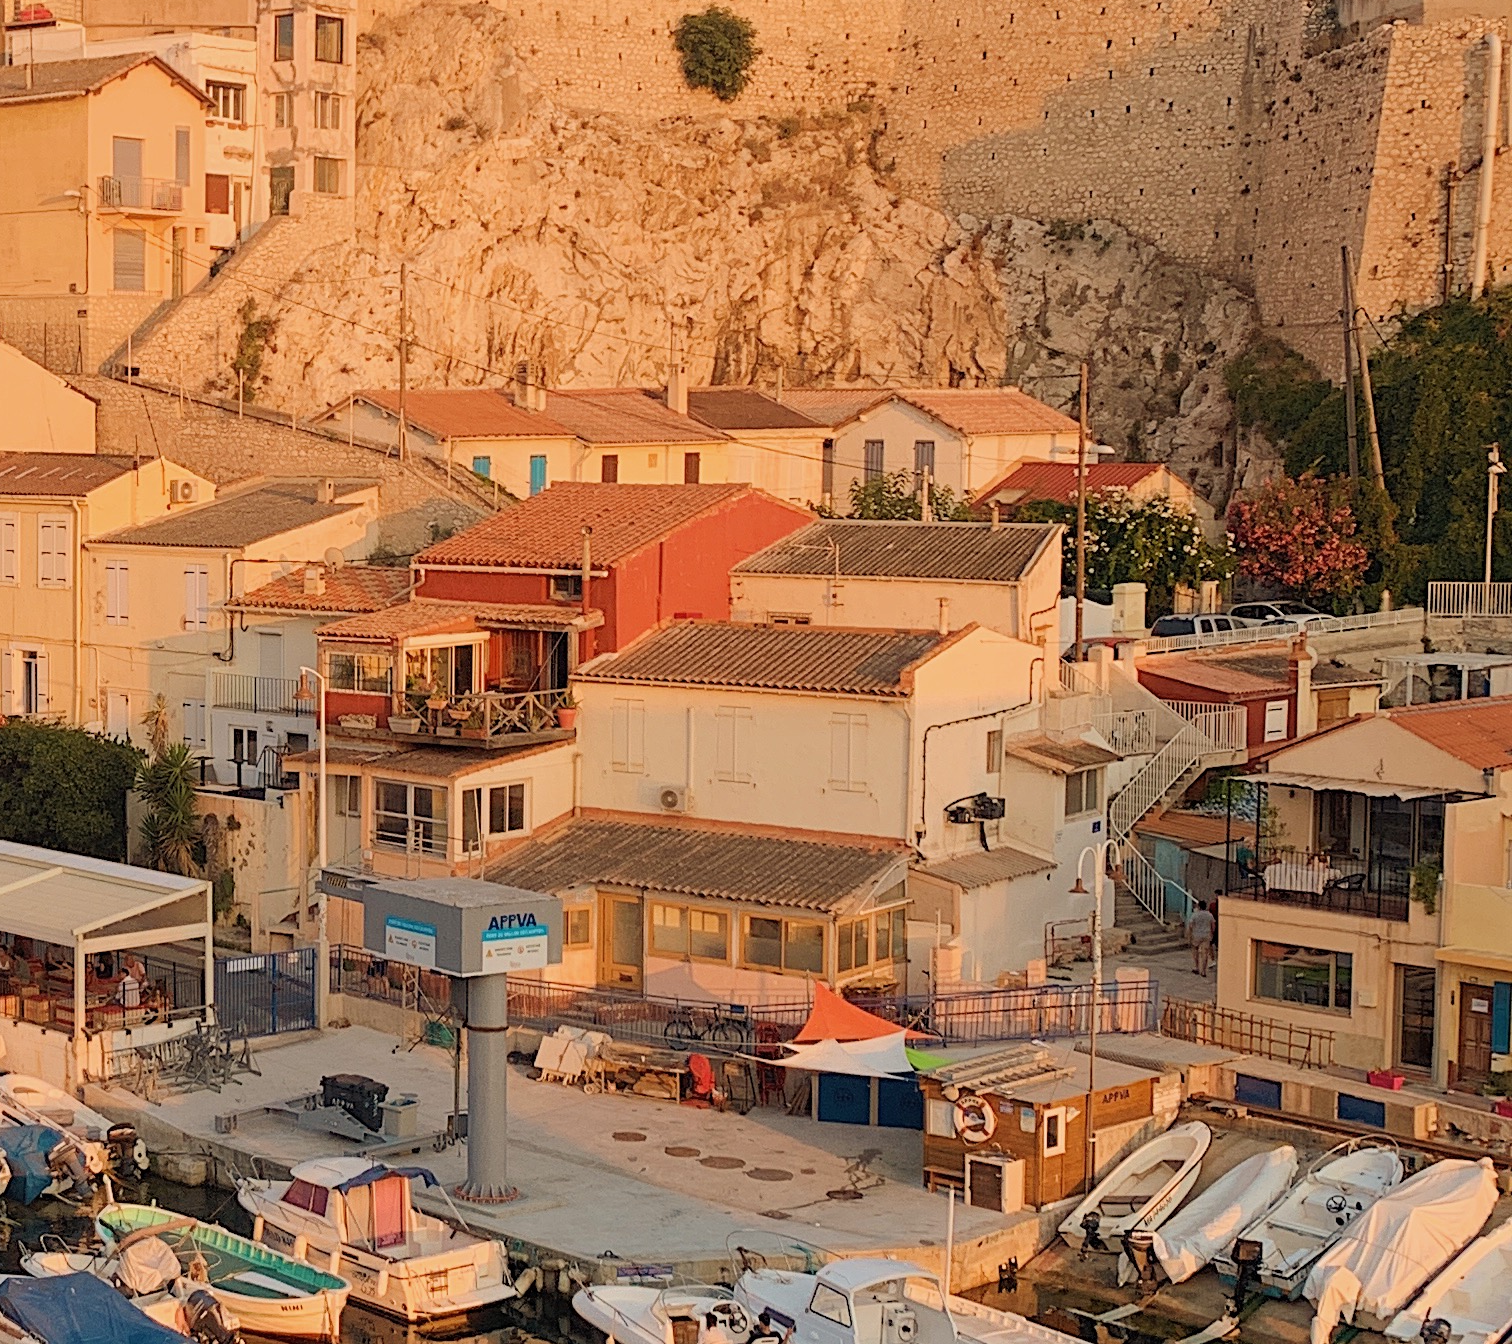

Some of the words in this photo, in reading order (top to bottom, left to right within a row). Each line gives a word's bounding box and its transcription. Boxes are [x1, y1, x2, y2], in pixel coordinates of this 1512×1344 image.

[487, 912, 537, 931] APPVA
[1101, 1089, 1131, 1105] APPVA
[280, 1304, 304, 1312] NINI
